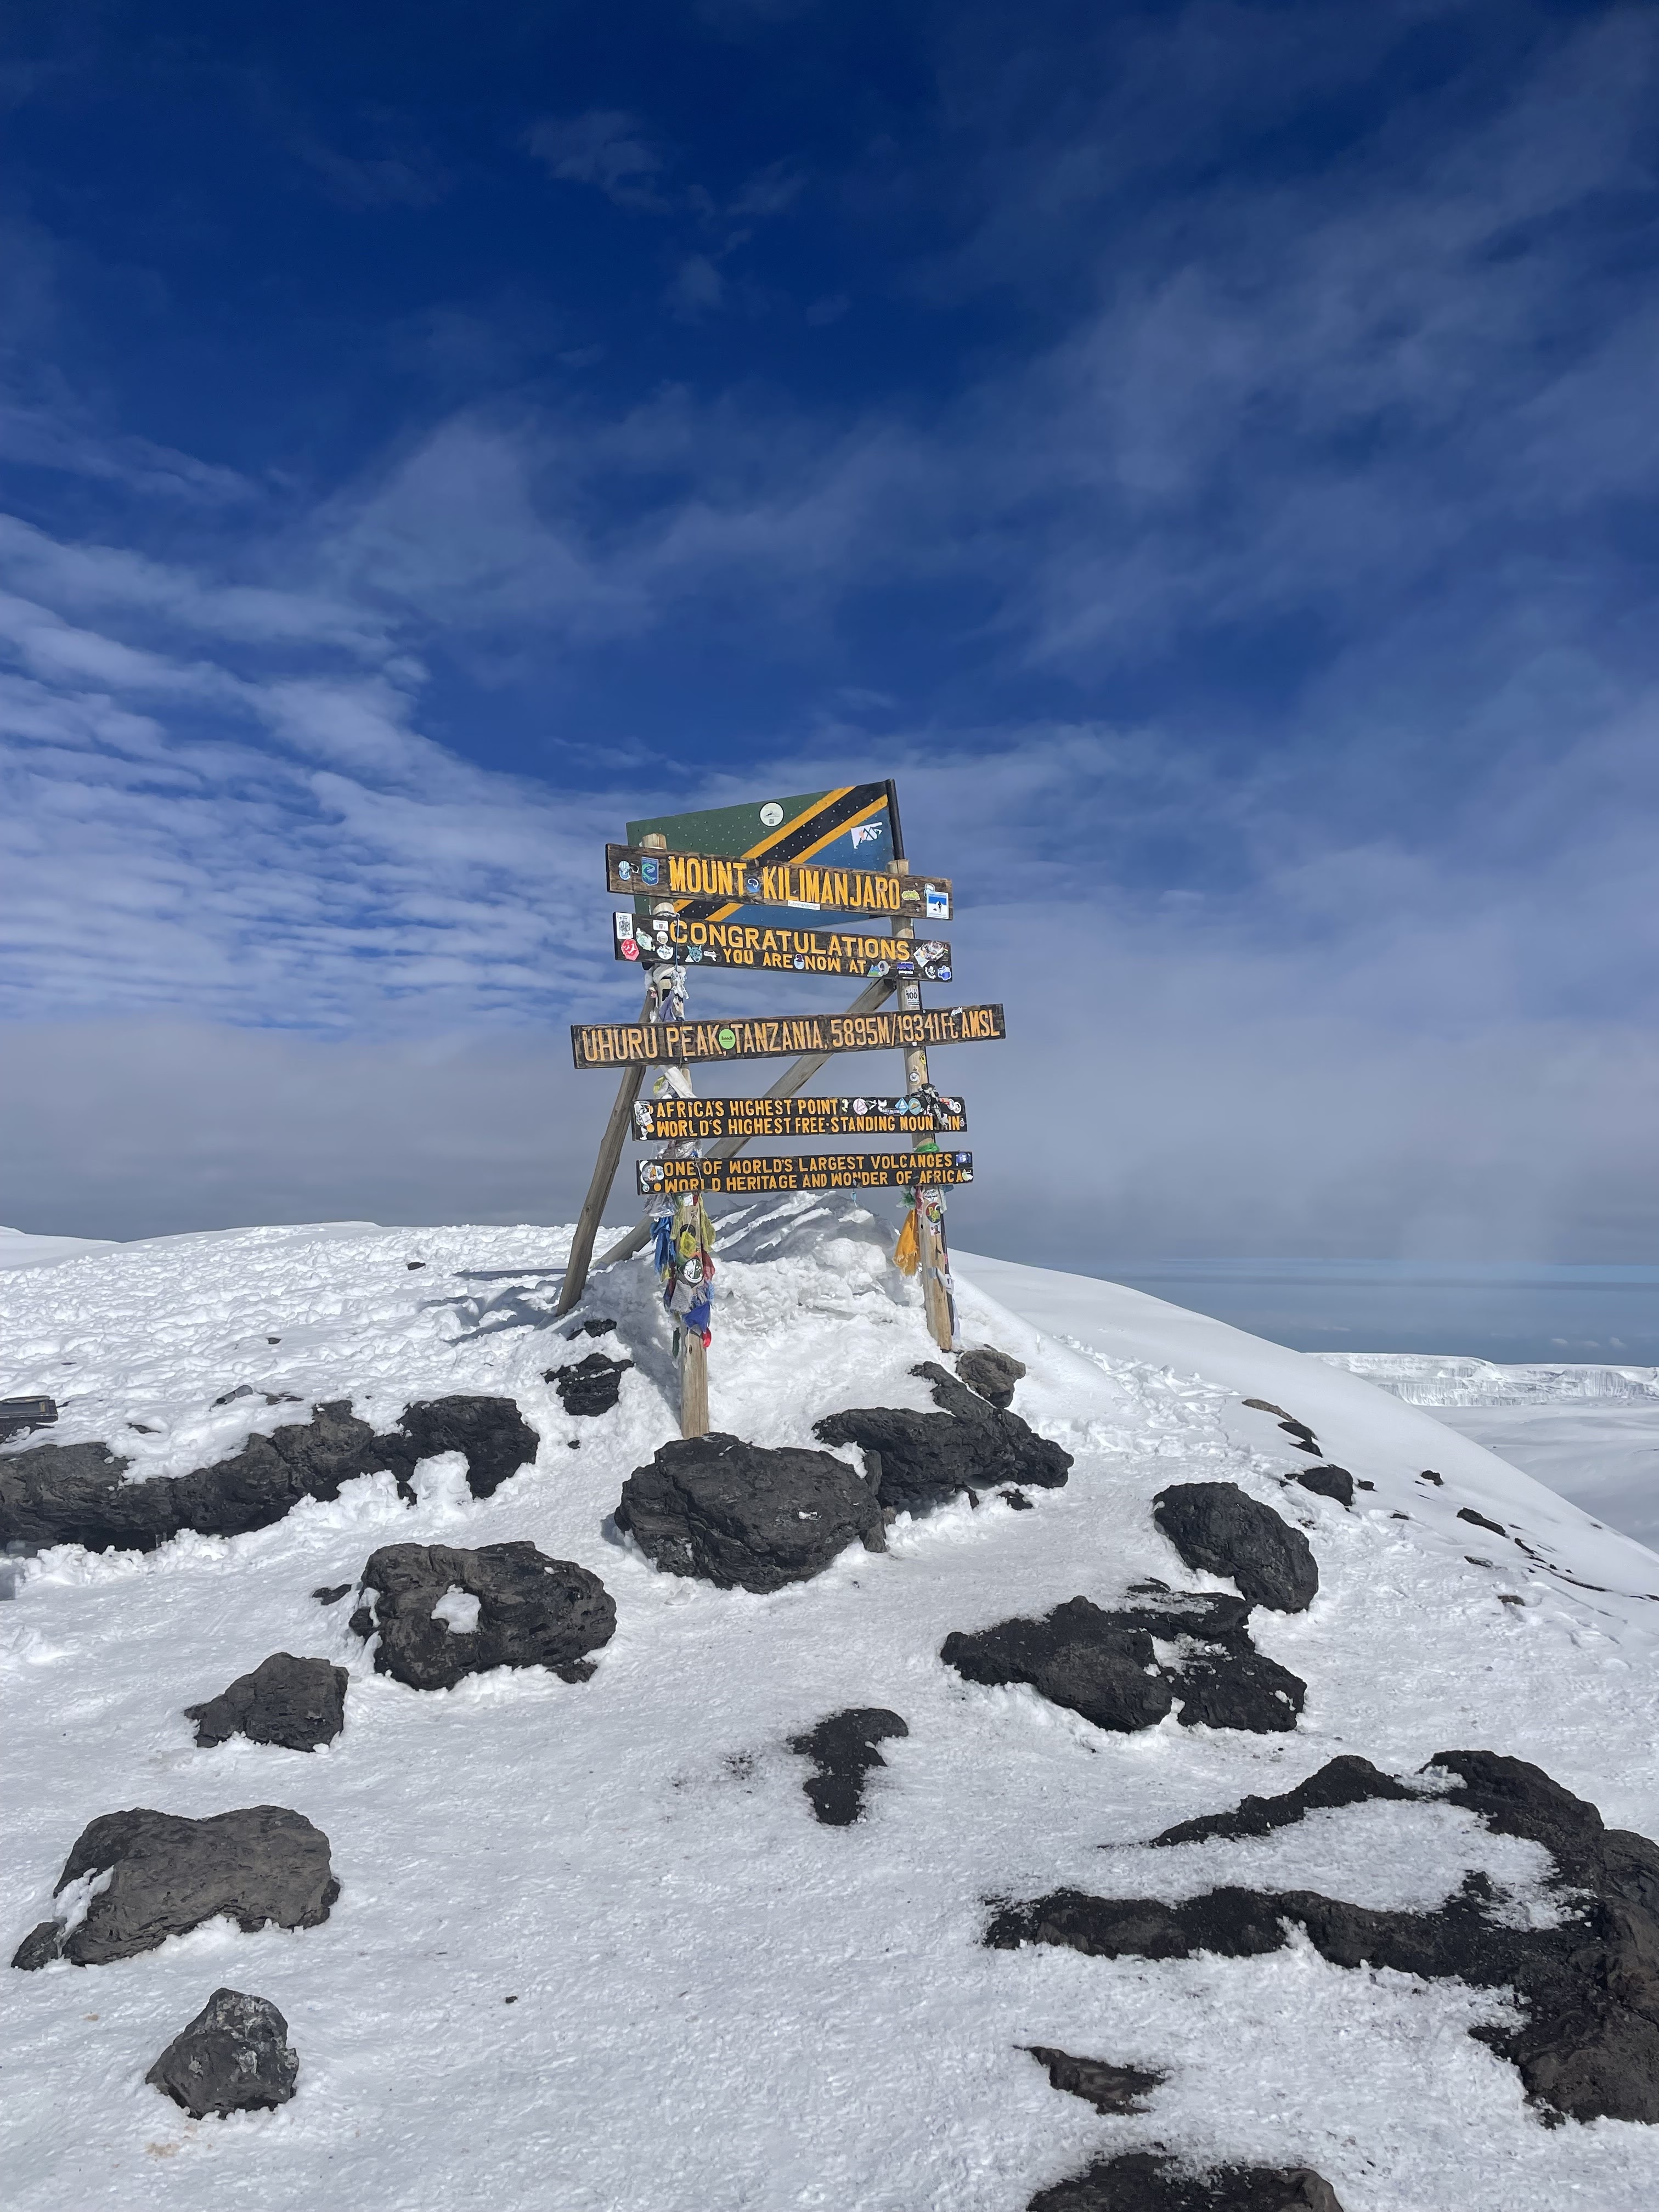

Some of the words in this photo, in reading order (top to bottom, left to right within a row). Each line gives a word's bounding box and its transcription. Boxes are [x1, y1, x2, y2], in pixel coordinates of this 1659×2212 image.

[668, 856, 747, 896] MOUNT
[761, 865, 901, 910] KILIMANJARO
[670, 919, 911, 961] CONGRATULATIONS
[723, 947, 754, 965] YOU
[763, 952, 793, 969] ARE
[805, 954, 842, 973] NOW
[849, 959, 866, 974] AT
[582, 1026, 658, 1061] UHURU
[961, 1009, 1000, 1037] AMSL
[657, 1101, 725, 1118] AFRICA'S
[729, 1099, 792, 1116] HIGHEST
[797, 1098, 838, 1115] POINT
[657, 1119, 723, 1137] WORLD'S
[728, 1117, 791, 1135] HIGHEST
[899, 1115, 961, 1132] MOUNIN
[663, 1161, 696, 1177] ONE
[703, 1160, 723, 1175] OF
[729, 1159, 793, 1175] WORLD'S
[798, 1156, 865, 1172] LARGEST
[871, 1153, 952, 1170] VOLCANOES
[726, 1174, 797, 1192] HERITAGE
[802, 1173, 827, 1188] AND
[895, 1170, 912, 1185] OF
[918, 1169, 963, 1185] AFRICA
